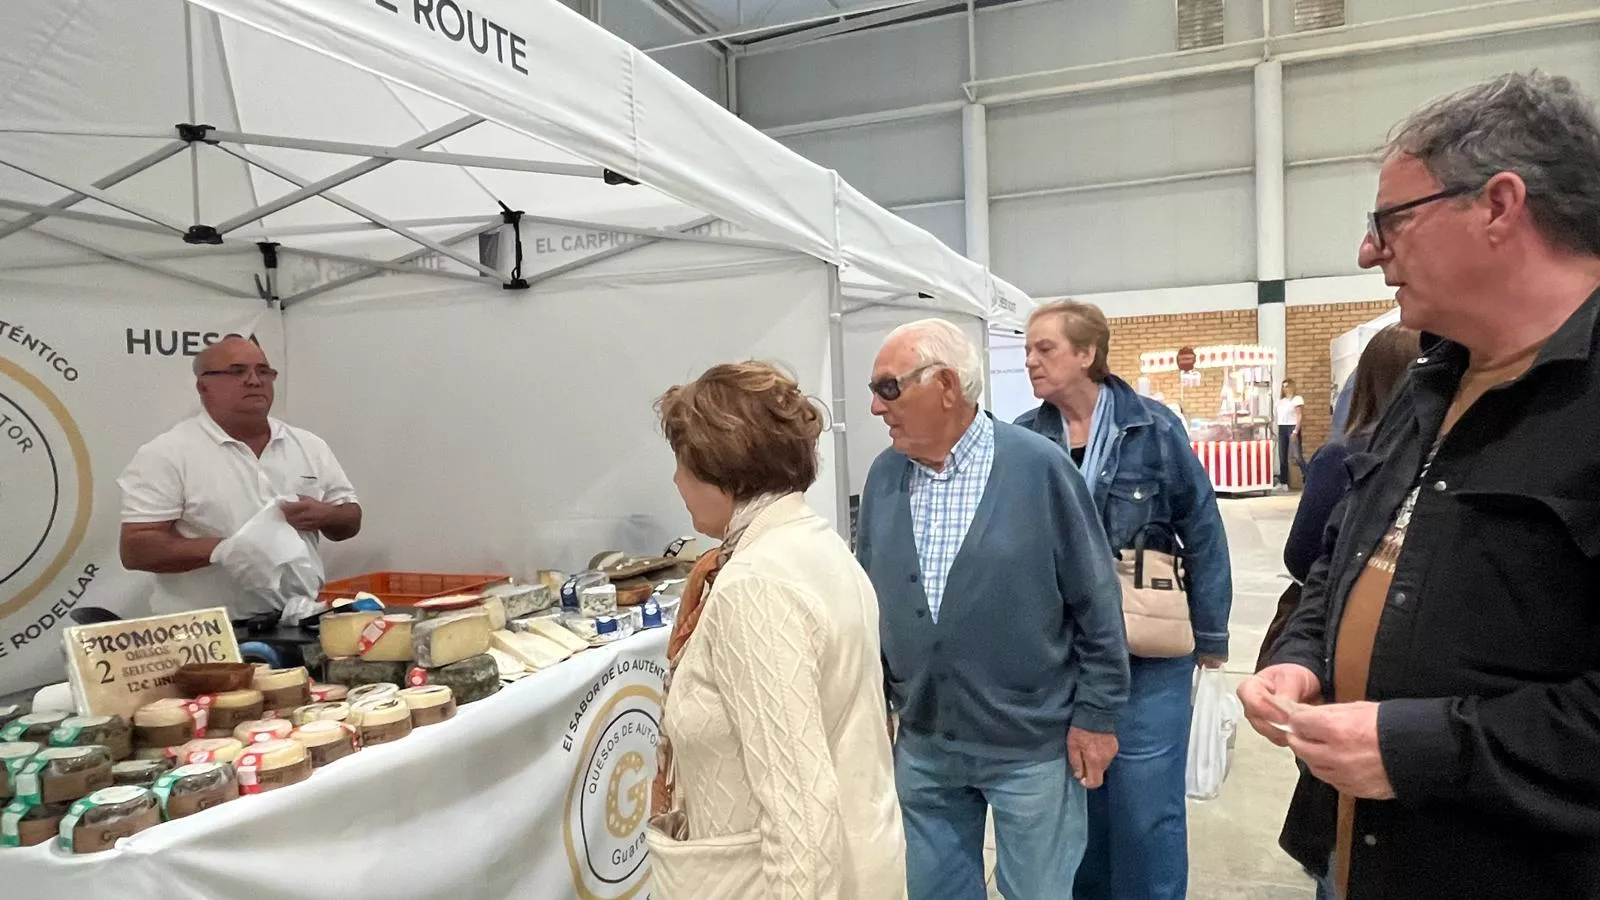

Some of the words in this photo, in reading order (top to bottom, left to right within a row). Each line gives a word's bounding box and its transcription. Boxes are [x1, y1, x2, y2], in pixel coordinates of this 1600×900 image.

[413, 0, 529, 76] ROUTE
[535, 238, 556, 254] EL
[561, 231, 627, 251] CARPIO
[126, 328, 261, 356] HUES
[10, 563, 100, 649] RODELLAR
[81, 616, 221, 656] PROMOCIÓN
[96, 660, 115, 684] 2
[178, 640, 226, 667] 20€
[126, 679, 150, 693] 12€
[569, 683, 600, 732] SABOR
[601, 667, 615, 686] DE
[617, 661, 630, 675] LO
[632, 659, 666, 680] AUTÉNT
[589, 732, 620, 794] QUESOS
[621, 722, 633, 737] DE
[635, 723, 657, 747] AUTO
[612, 832, 646, 865] Guara
